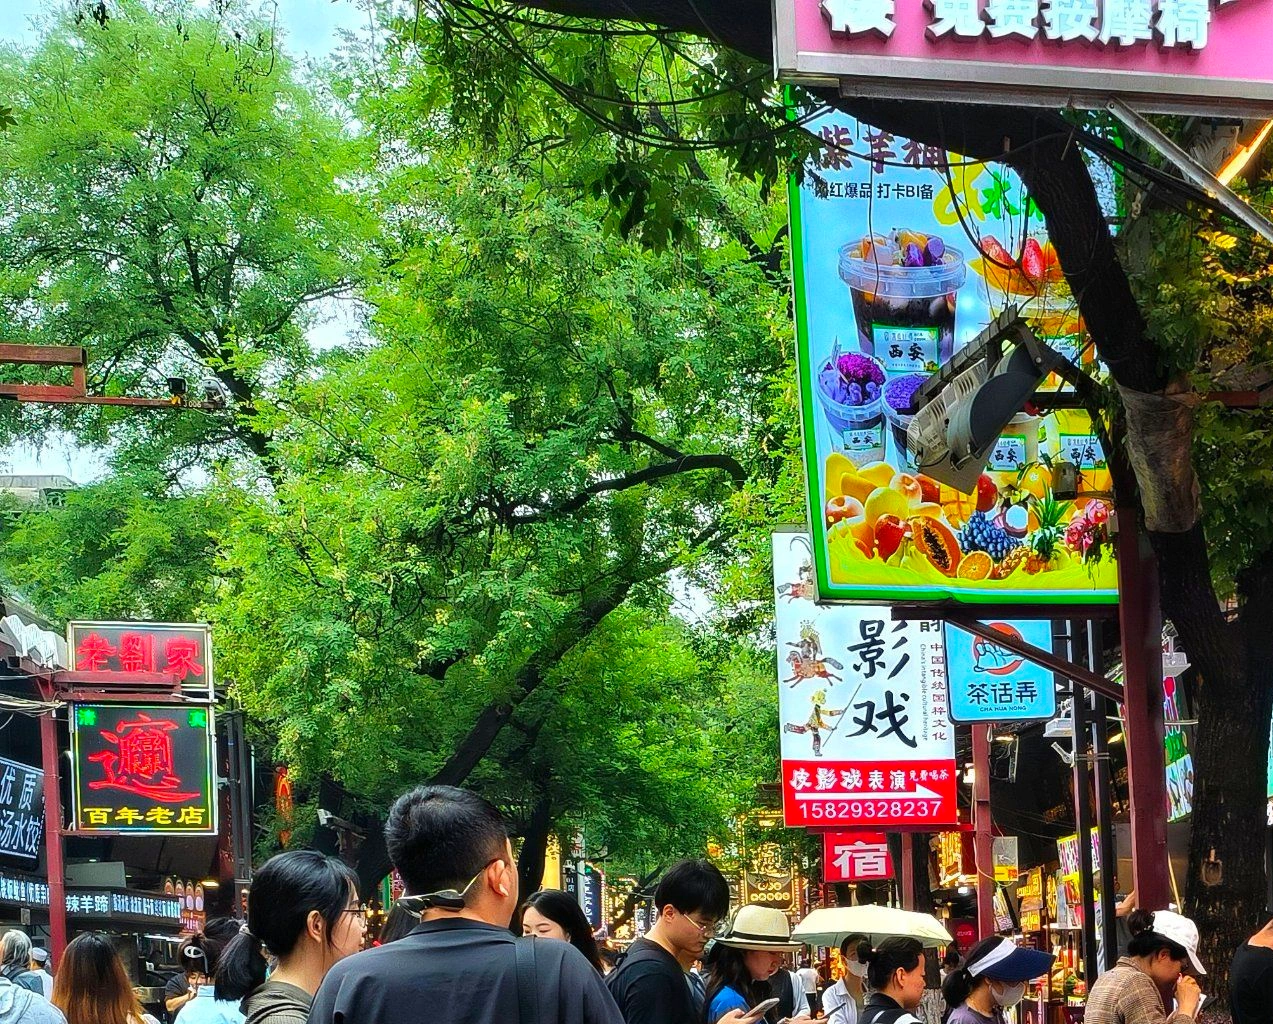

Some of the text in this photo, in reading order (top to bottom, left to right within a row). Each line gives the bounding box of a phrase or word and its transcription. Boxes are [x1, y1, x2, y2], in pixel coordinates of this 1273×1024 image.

[889, 343, 925, 361] 西安
[967, 682, 1037, 705] 茶话弄
[0, 765, 37, 811] 优质
[790, 767, 906, 790] 皮影戏表演
[84, 806, 205, 826] 百年老店
[799, 801, 942, 819] 15829328237
[832, 841, 887, 878] 宿
